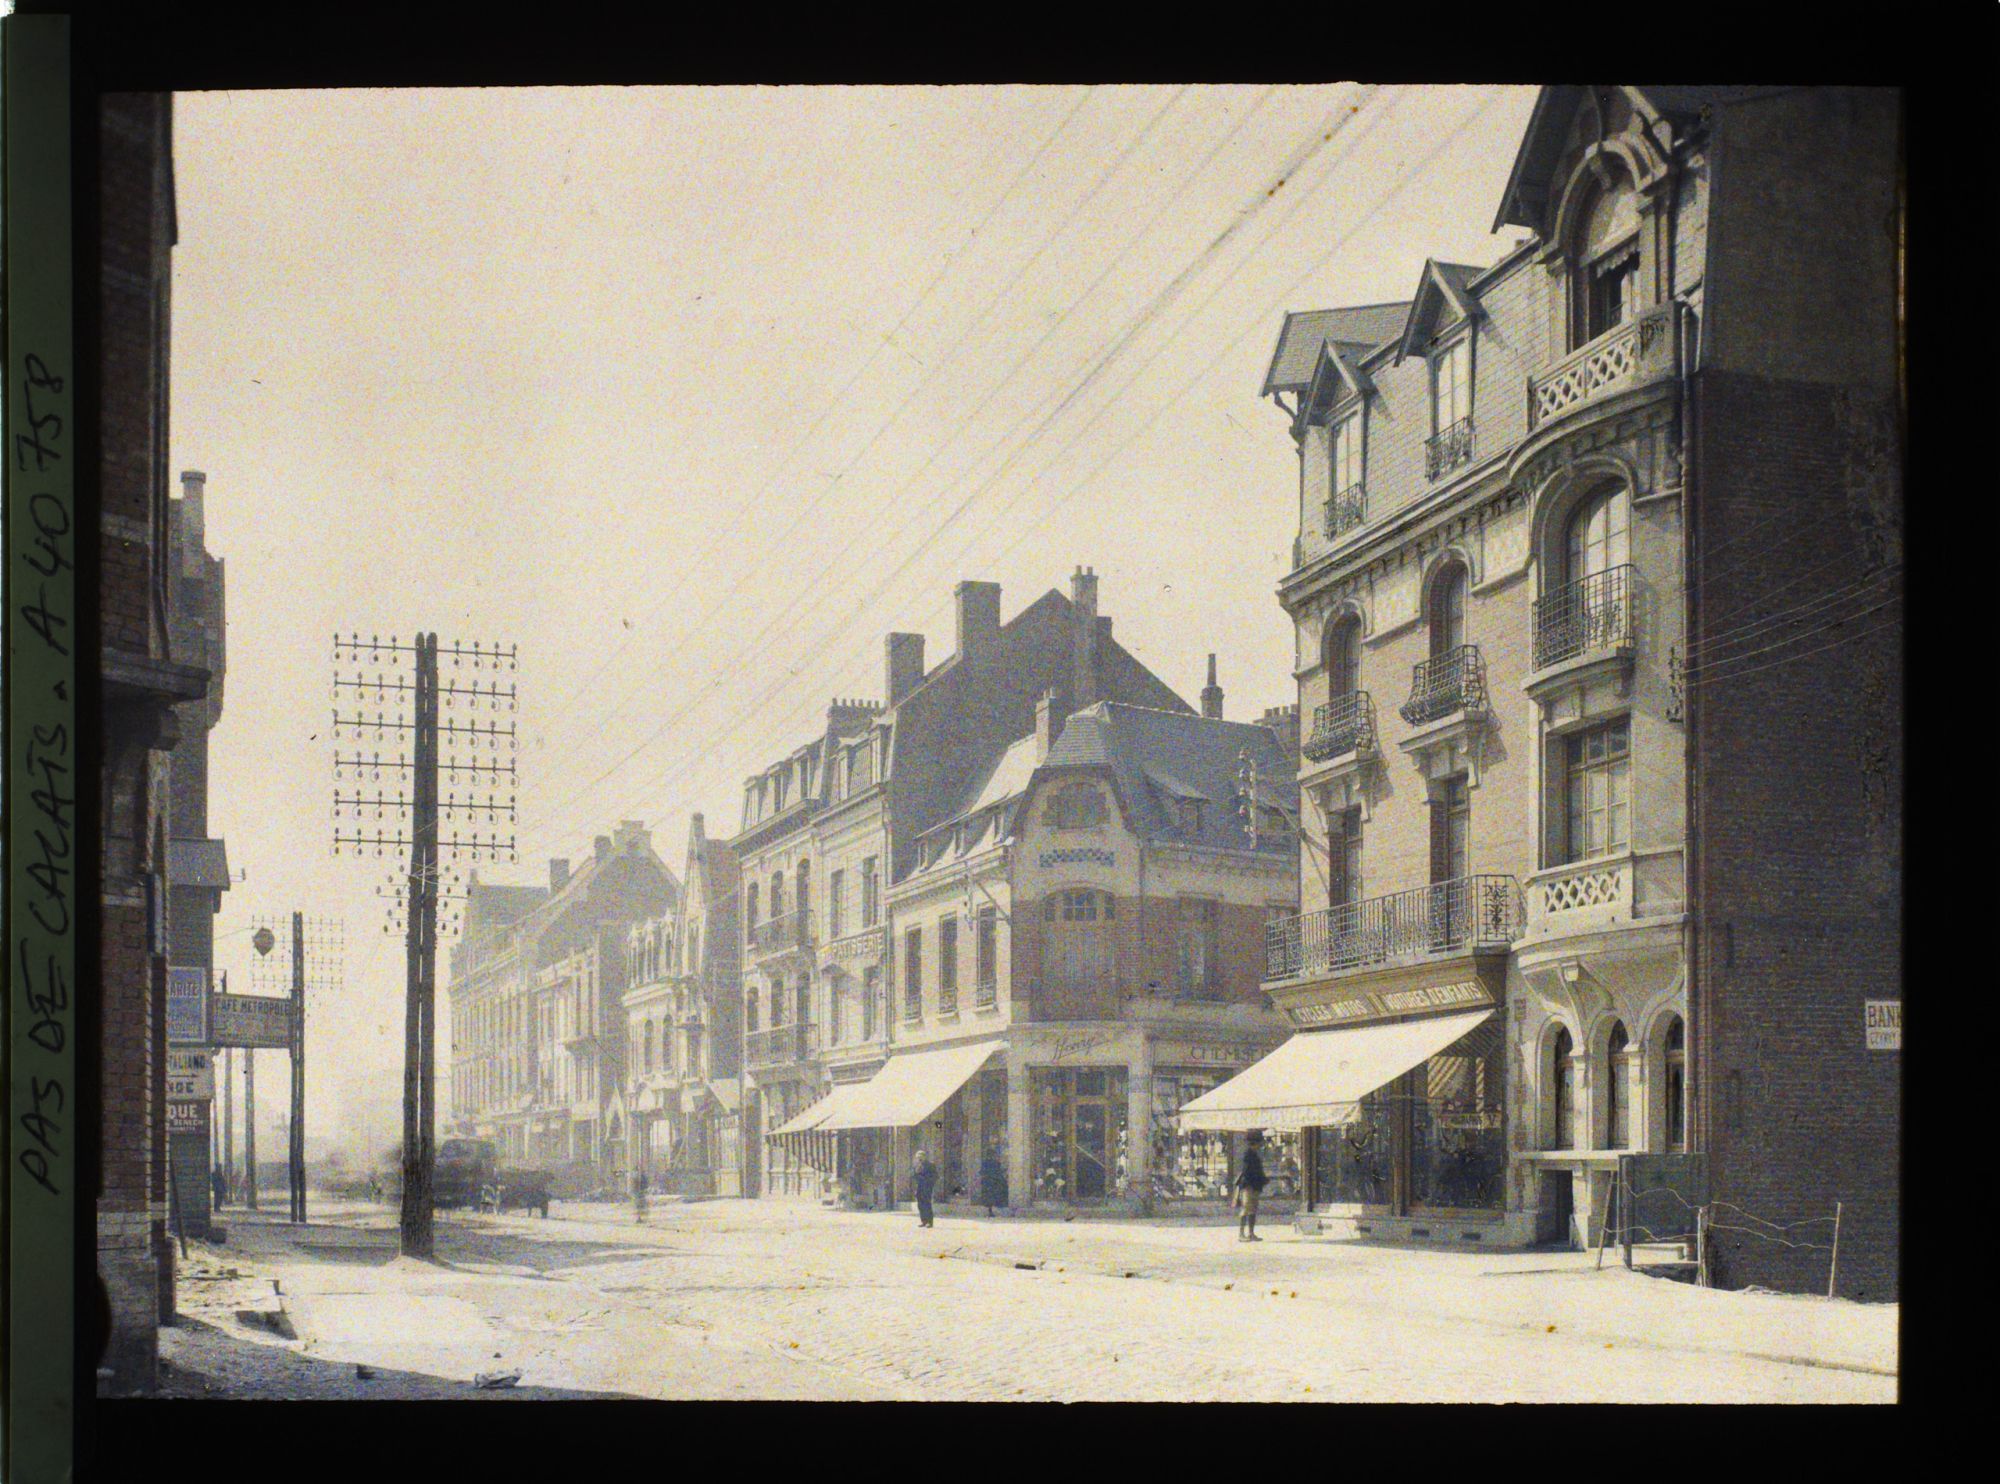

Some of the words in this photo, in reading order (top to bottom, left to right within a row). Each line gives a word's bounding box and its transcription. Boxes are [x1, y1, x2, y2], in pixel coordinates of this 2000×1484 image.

[20, 937, 68, 1054] DE
[1295, 1004, 1332, 1023] CYCLES
[1330, 999, 1368, 1019] MOTOS
[1381, 989, 1430, 1011] VOITURES
[1426, 981, 1484, 1005] D'ENFANTS
[19, 1076, 64, 1196] PAS
